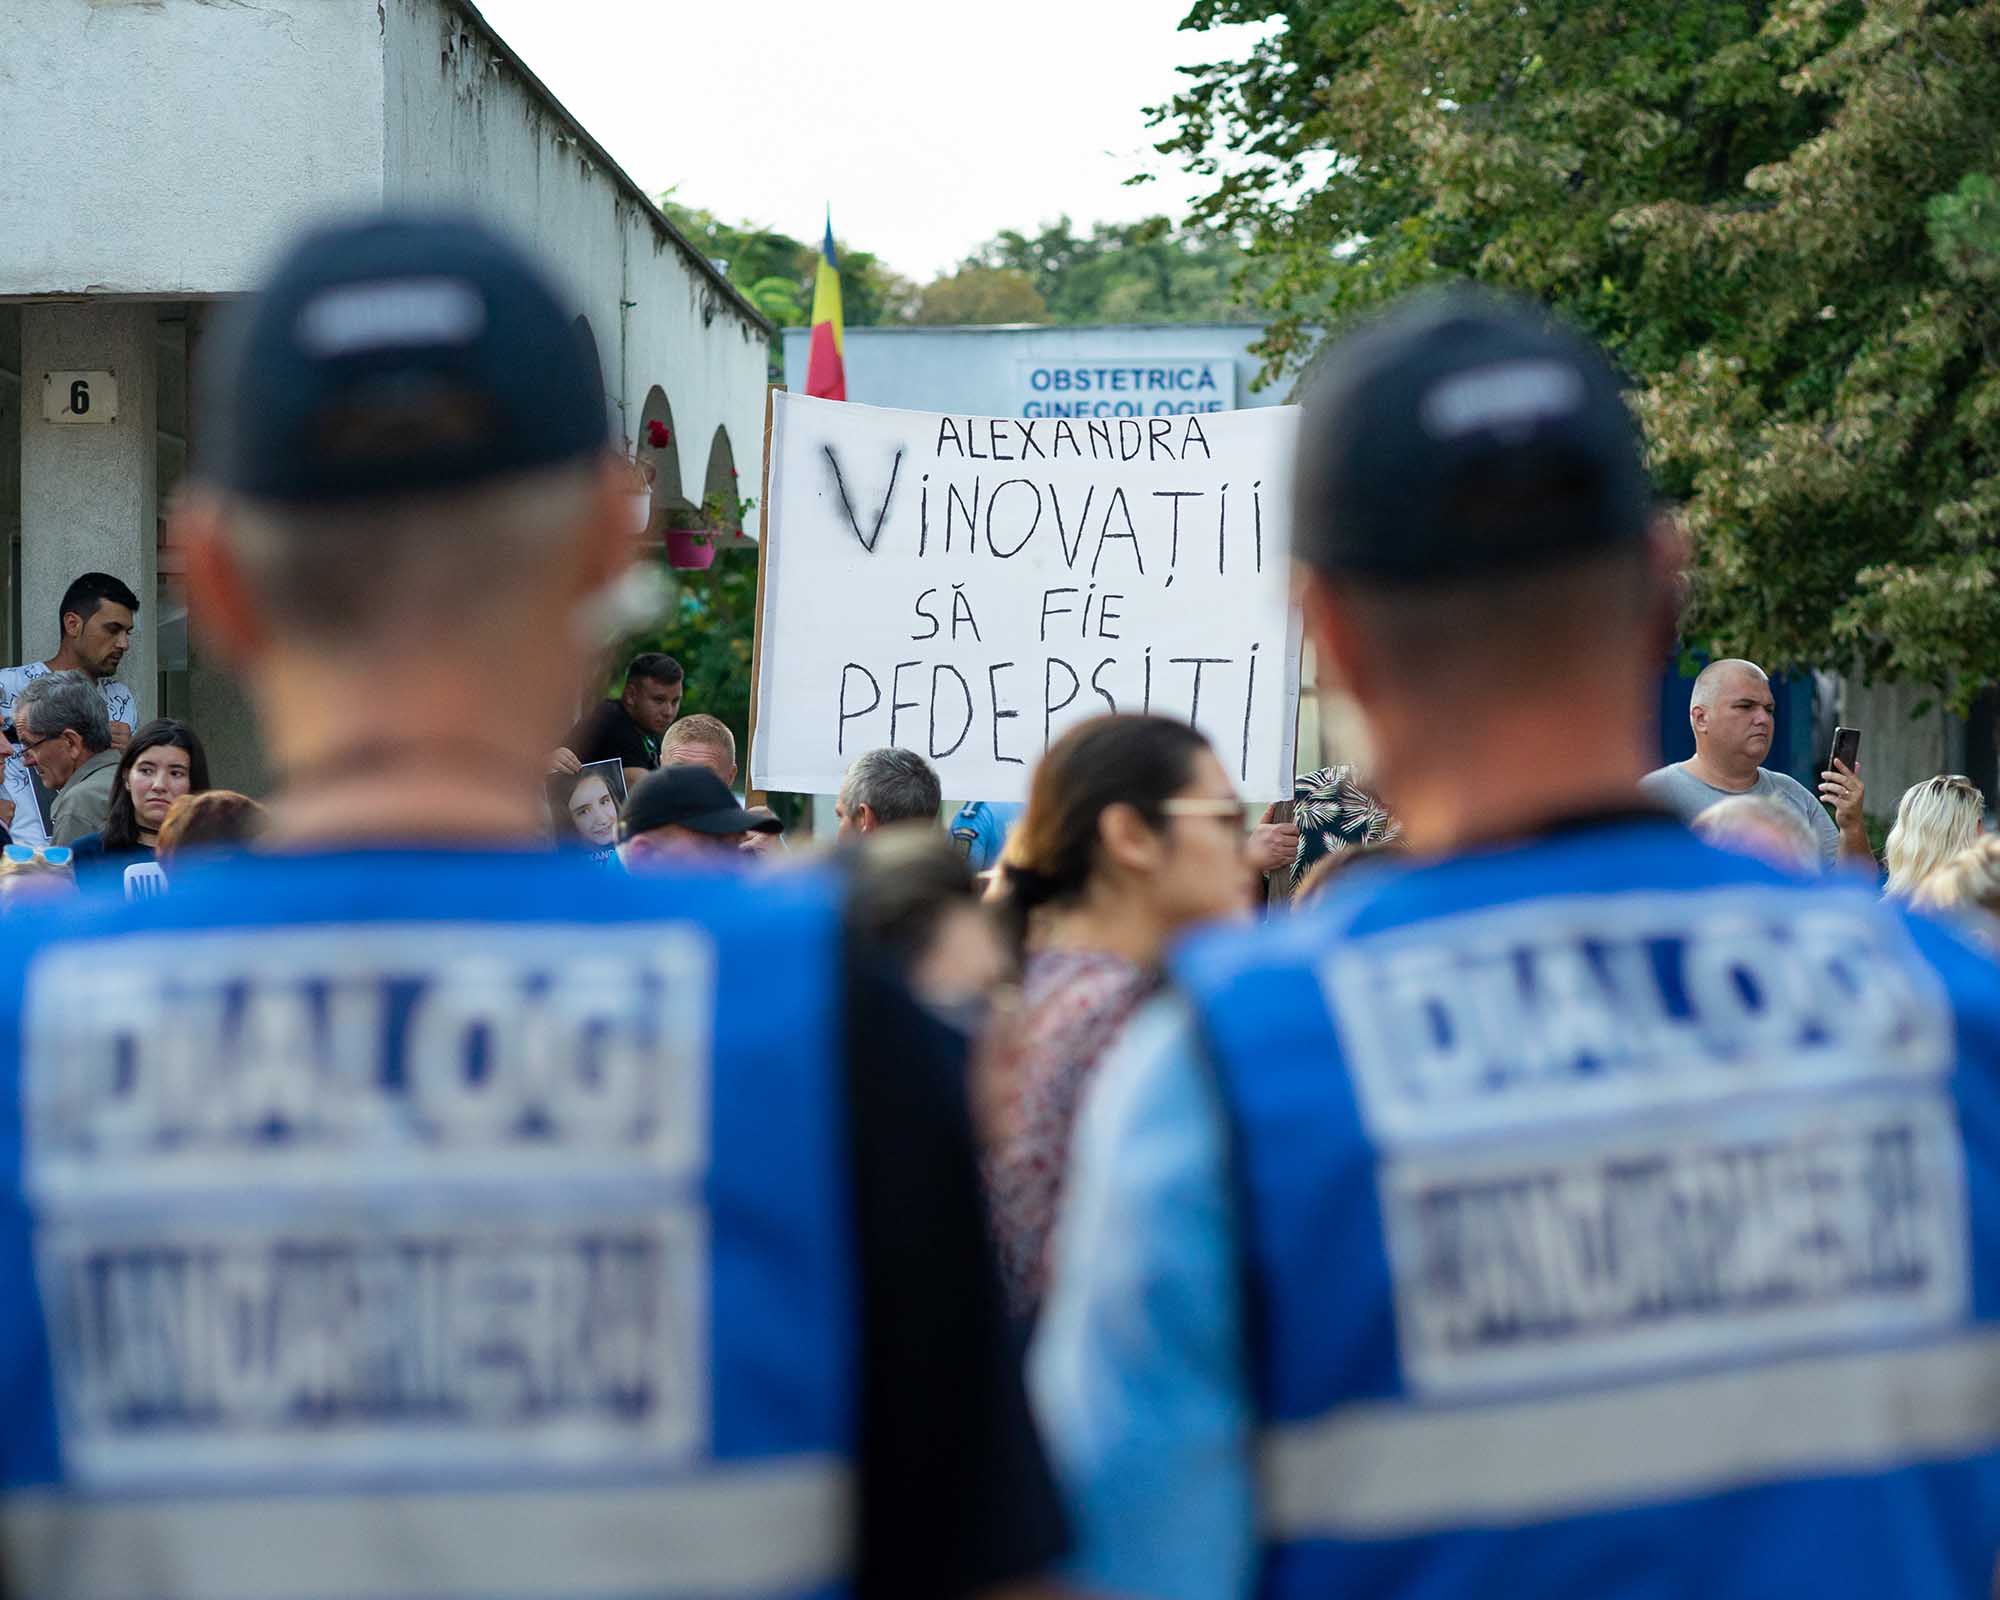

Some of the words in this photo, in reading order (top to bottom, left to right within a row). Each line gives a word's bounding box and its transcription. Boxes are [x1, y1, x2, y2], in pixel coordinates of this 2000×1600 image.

[70, 380, 90, 415] 6
[937, 416, 1211, 461] ALEXANDRA
[911, 582, 981, 642] SĂ
